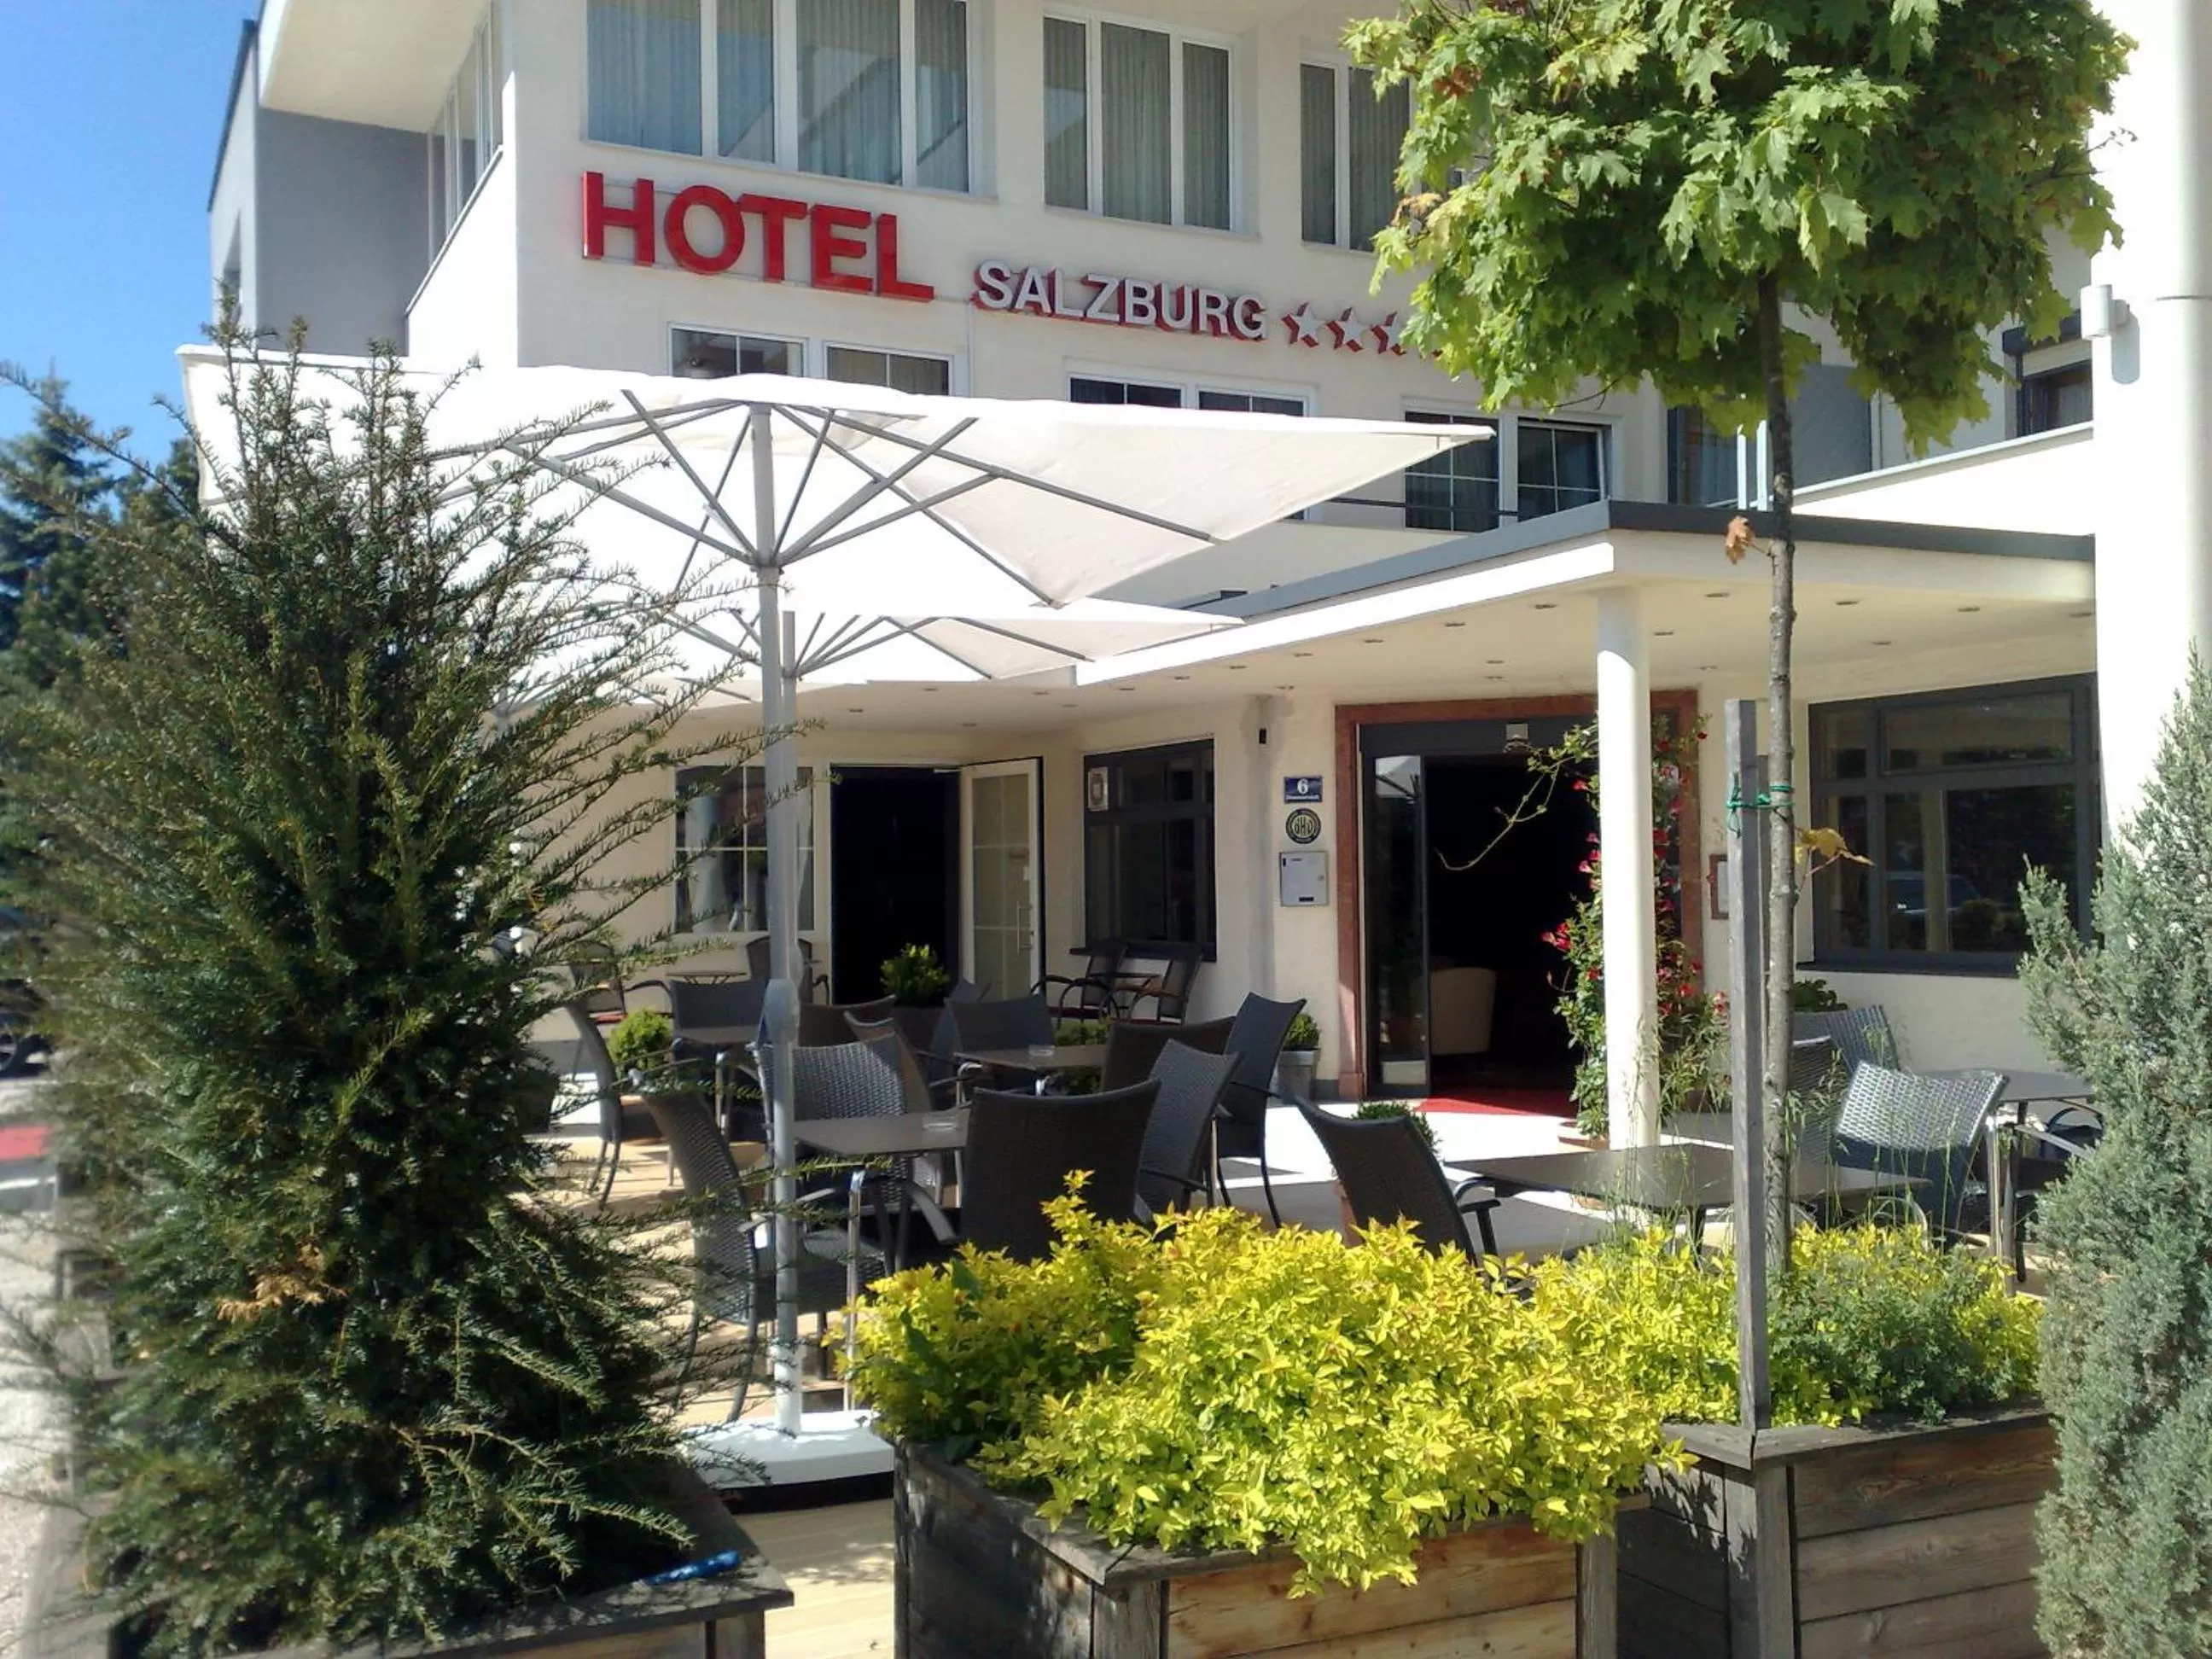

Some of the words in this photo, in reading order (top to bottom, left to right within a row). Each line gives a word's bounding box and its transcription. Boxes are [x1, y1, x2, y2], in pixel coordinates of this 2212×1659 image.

[584, 172, 934, 302] HOTEL
[971, 259, 1267, 341] SALZBURG
[1297, 778, 1309, 795] 6
